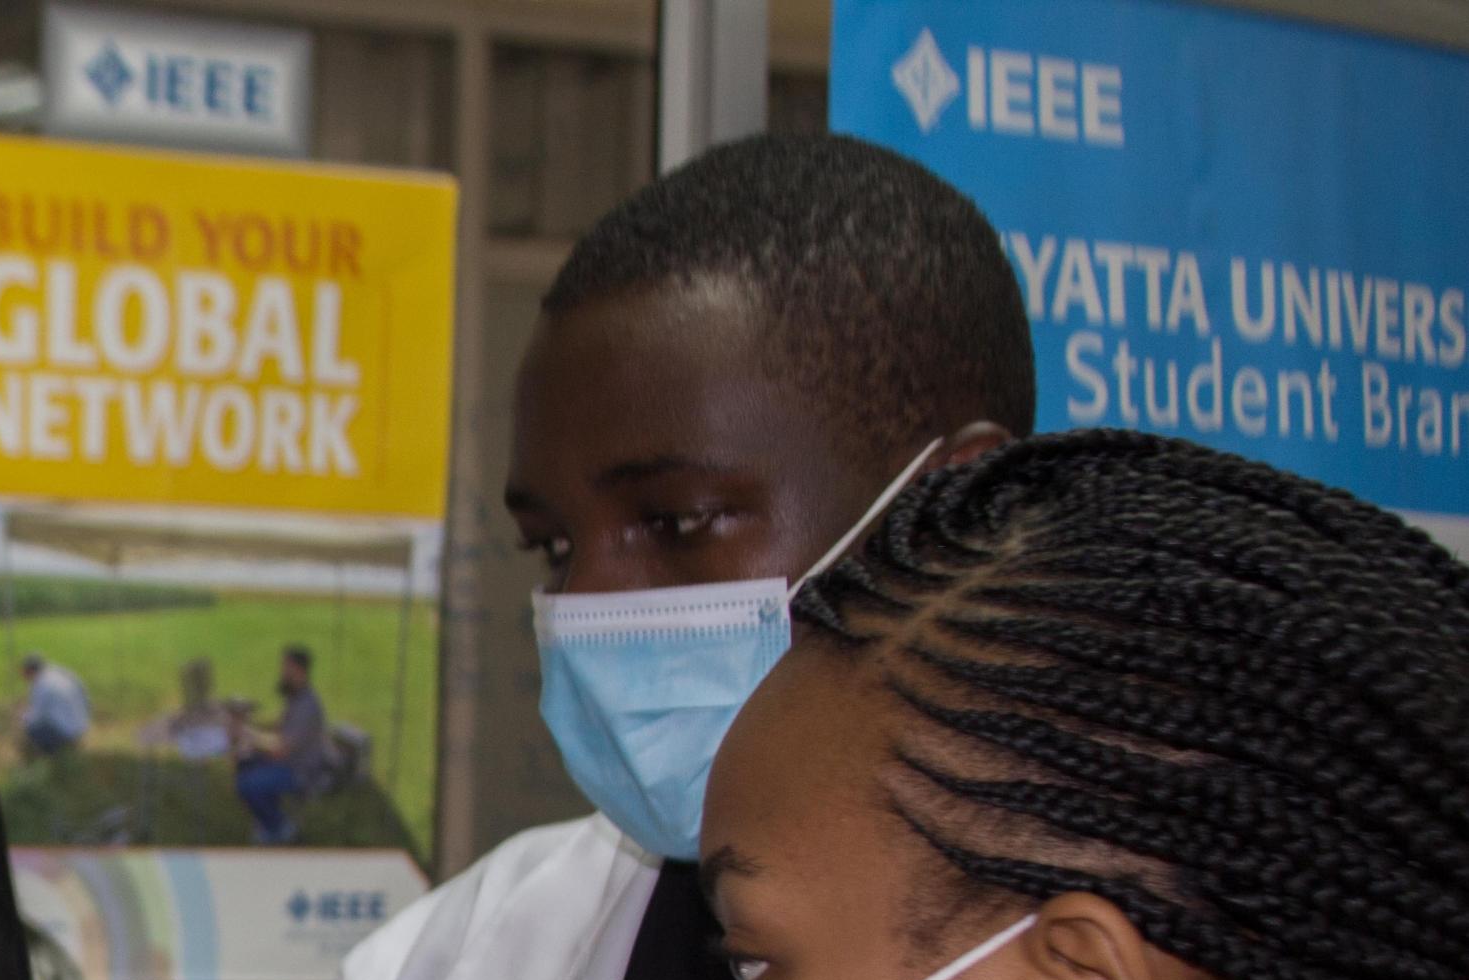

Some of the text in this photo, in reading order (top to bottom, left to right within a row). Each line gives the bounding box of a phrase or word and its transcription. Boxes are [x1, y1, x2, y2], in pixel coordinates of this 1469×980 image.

[144, 51, 276, 116] IEEE
[967, 45, 1124, 149] IEEE
[194, 208, 363, 278] YOUR
[1001, 232, 1209, 337] YATTA
[1064, 331, 1338, 442] Student
[318, 891, 387, 921] IEEE
